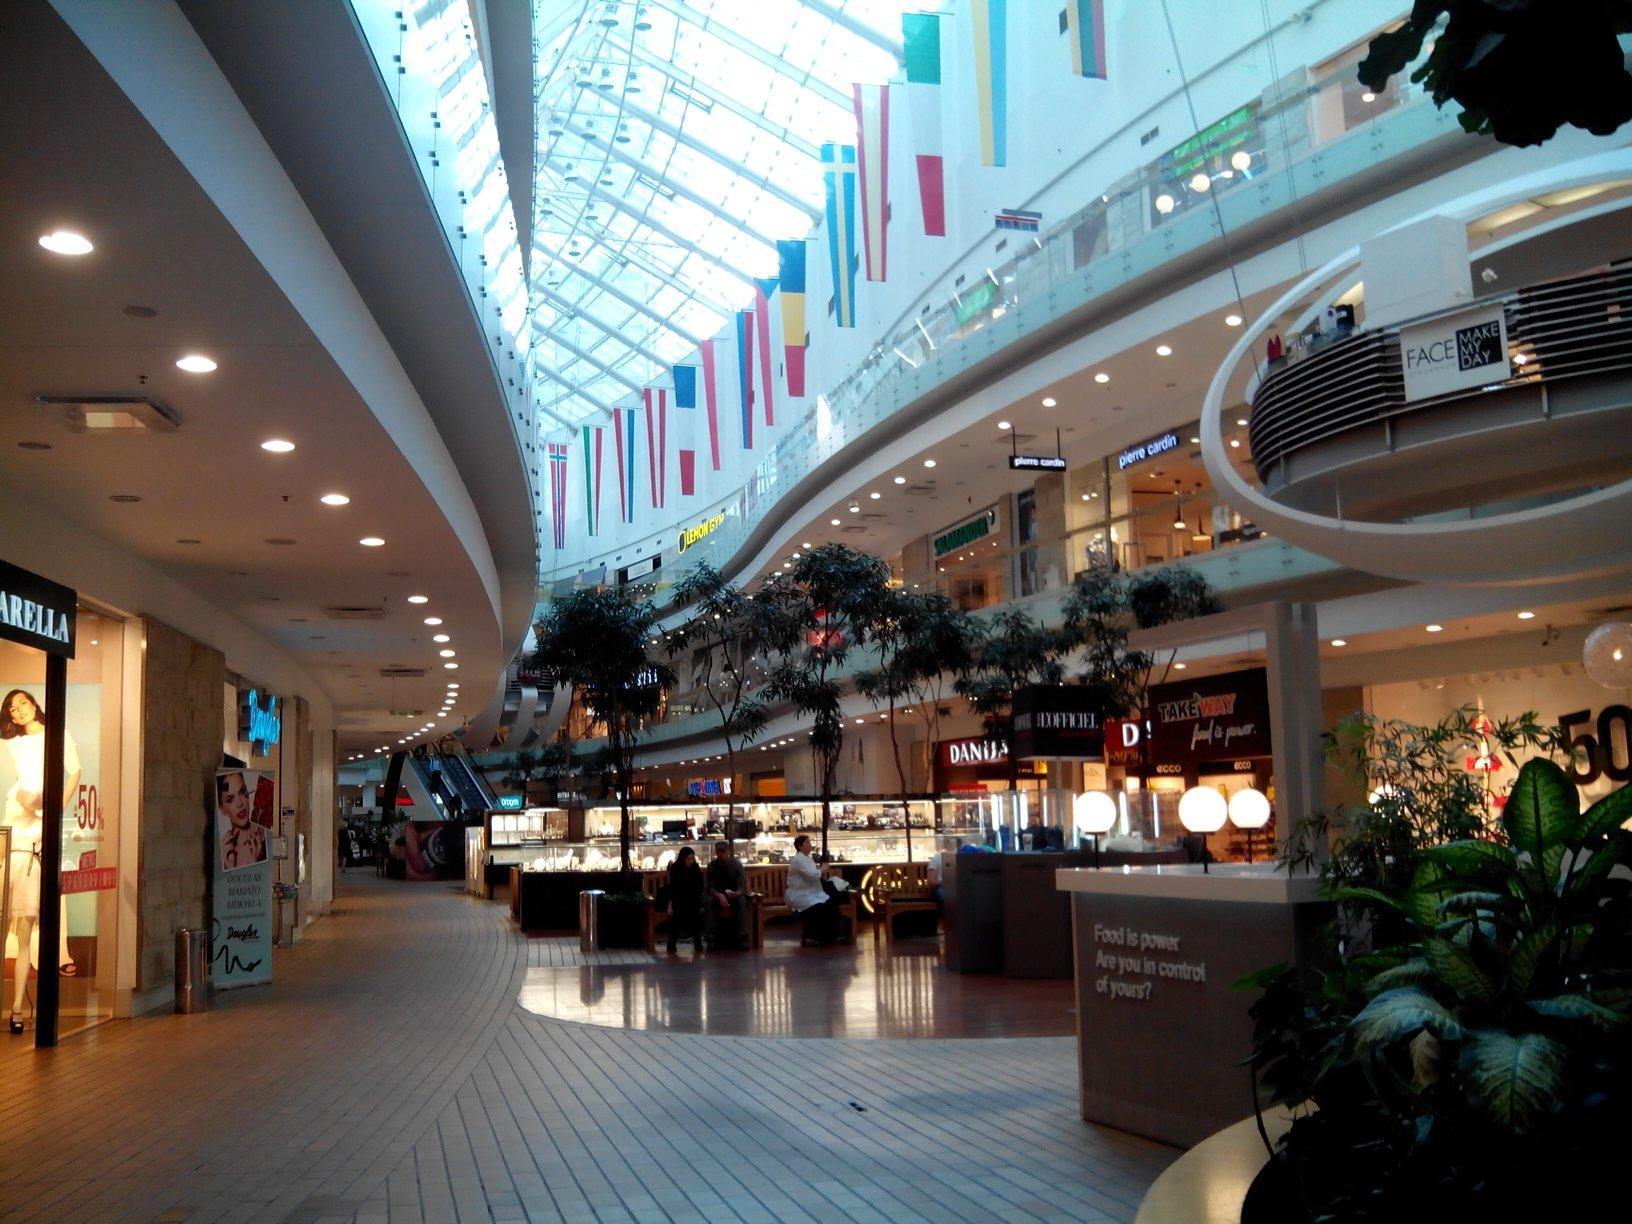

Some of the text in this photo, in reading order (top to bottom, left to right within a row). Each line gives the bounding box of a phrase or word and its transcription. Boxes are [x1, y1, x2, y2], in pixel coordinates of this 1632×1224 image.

[1459, 322, 1499, 343] MAKE
[1406, 340, 1455, 369] FACE
[1460, 339, 1482, 356] MY
[1461, 350, 1491, 369] DAY
[1014, 457, 1065, 468] pierre cardin
[1119, 434, 1177, 469] pierre cardin
[687, 512, 726, 546] LEMON GYM
[1094, 924, 1181, 952] Food is power
[1096, 949, 1206, 983] Are you in control
[1096, 975, 1153, 1000] of yours?
